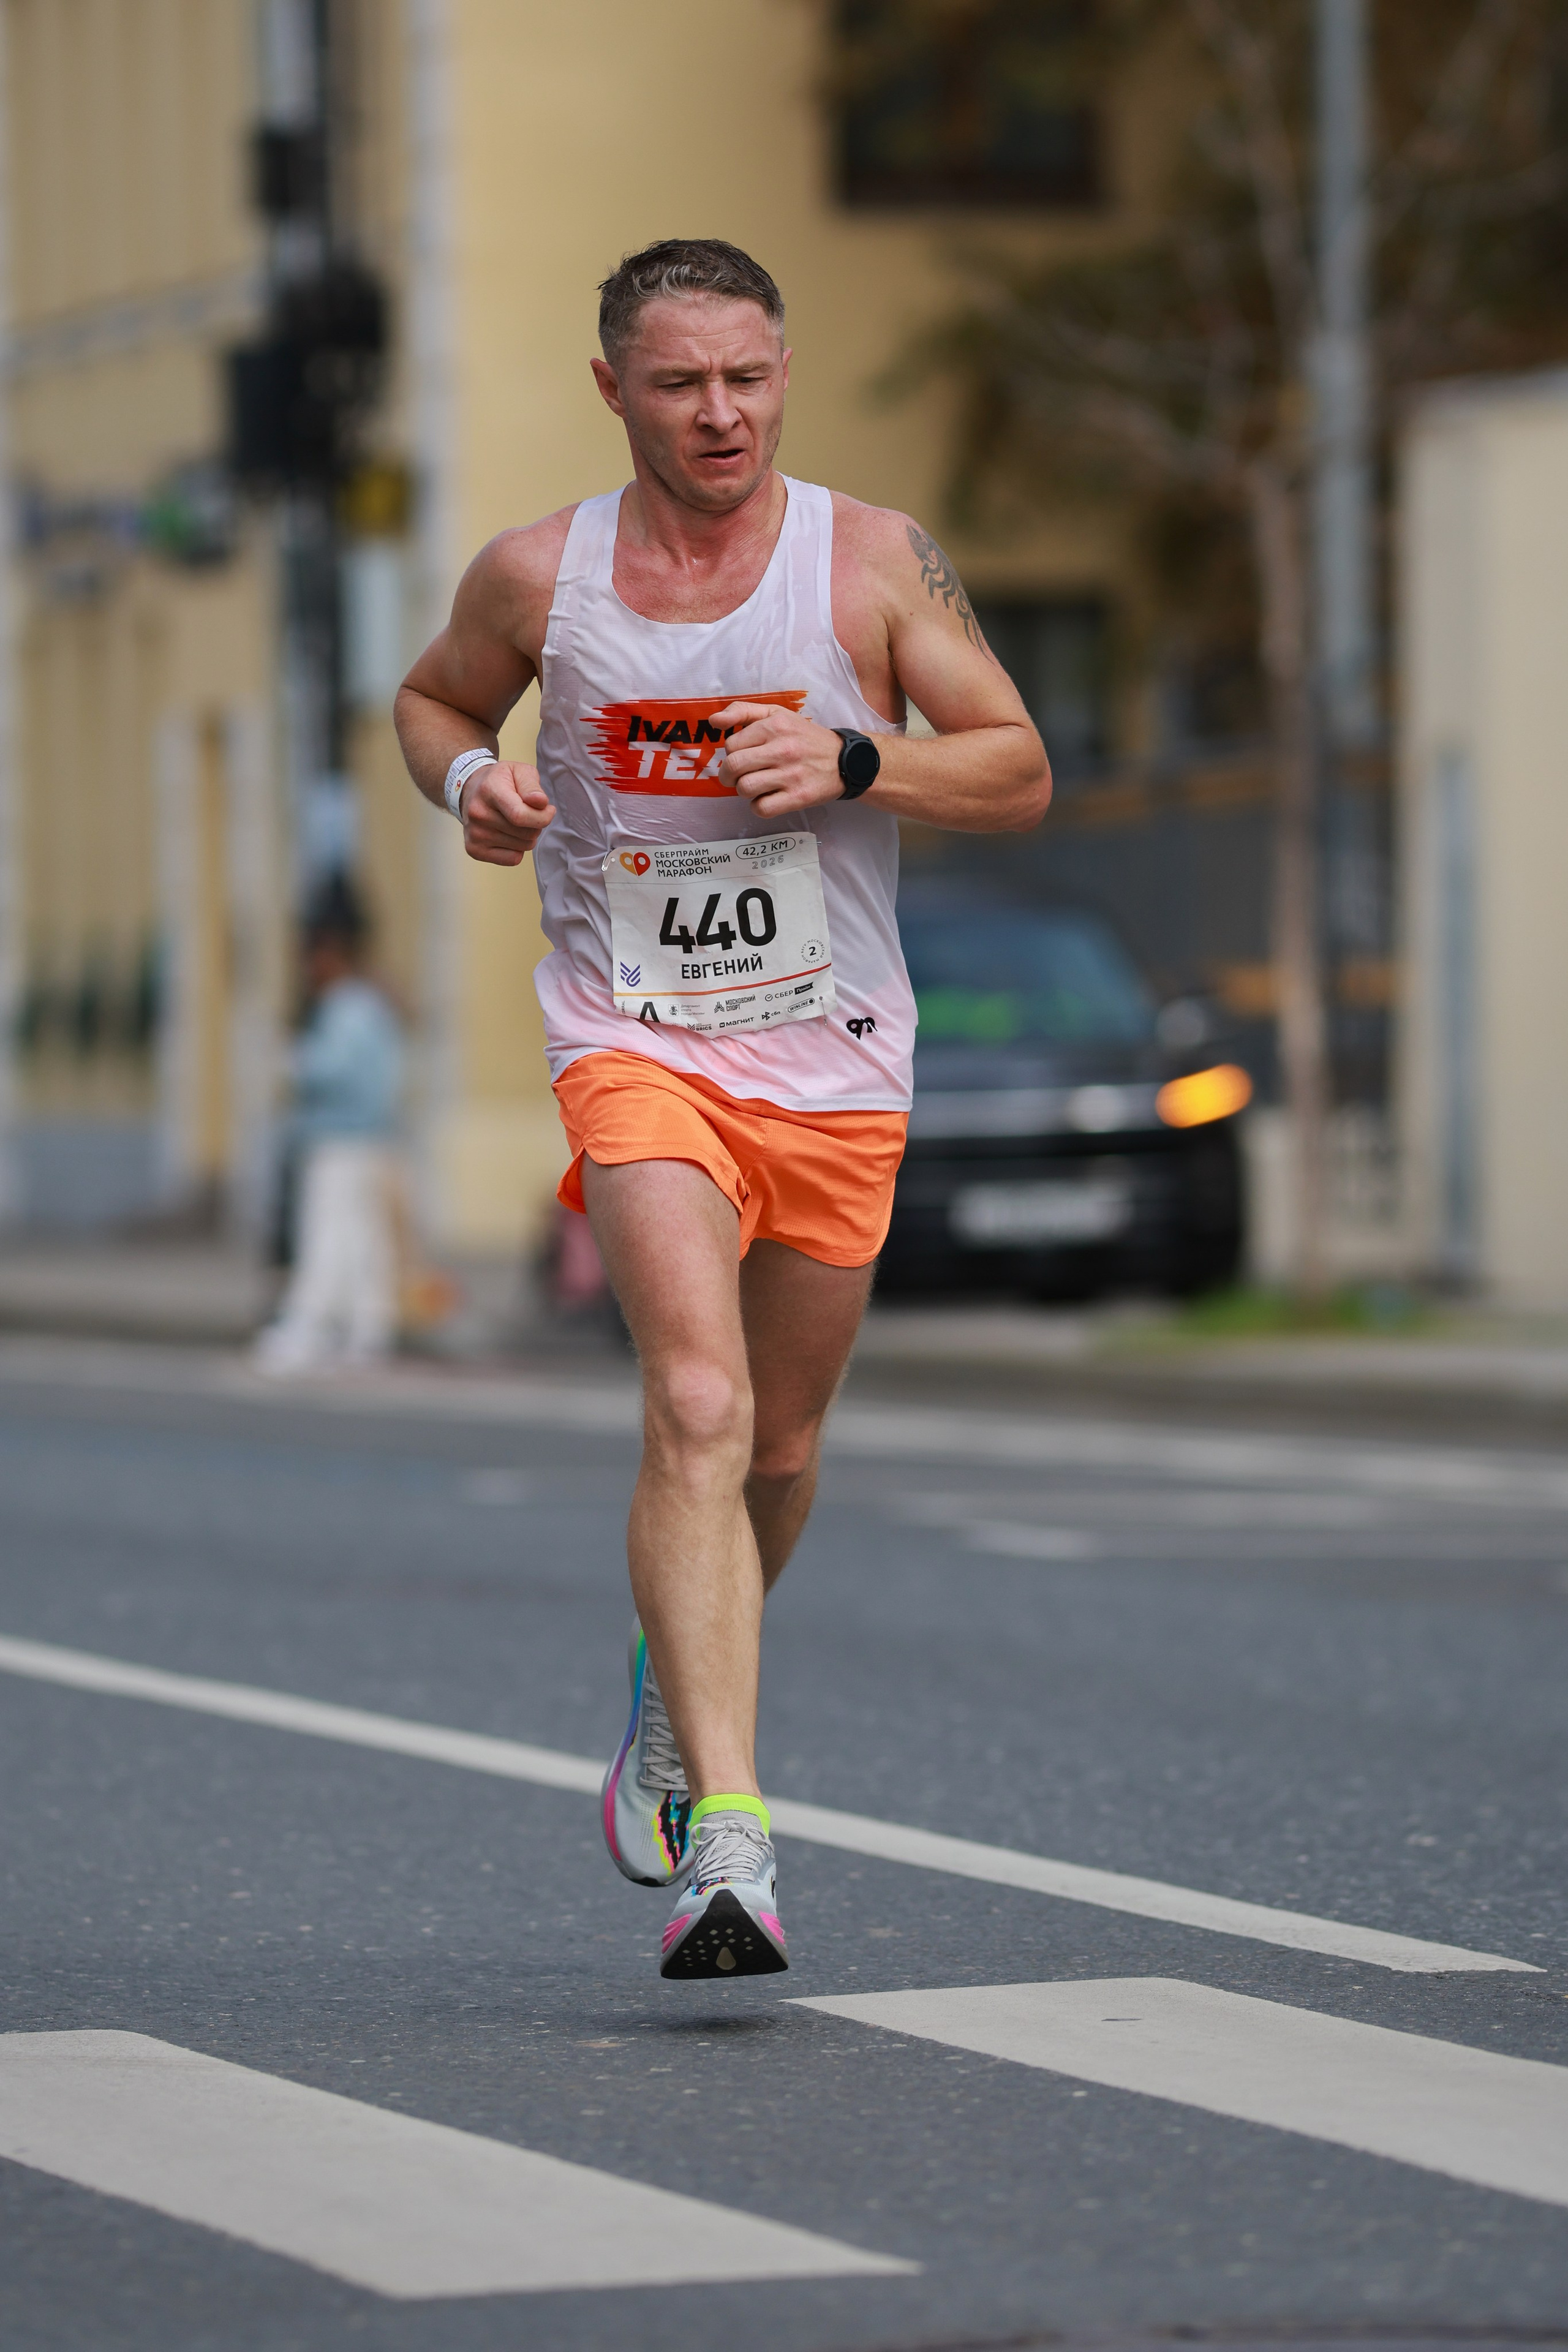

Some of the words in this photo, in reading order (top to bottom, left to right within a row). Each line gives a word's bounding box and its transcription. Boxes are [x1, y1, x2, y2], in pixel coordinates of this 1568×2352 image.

[627, 715, 748, 744] IVAN
[654, 848, 709, 858] СБЕРПРАЙМ
[742, 845, 767, 856] 42,2
[655, 854, 731, 868] МОСКОВСКИЙ
[752, 855, 784, 869] 2026
[657, 866, 712, 877] МАРАФОН
[659, 888, 777, 954] 440
[809, 946, 816, 956] 2
[681, 952, 763, 979] ЕВГЕНИЙ
[774, 990, 793, 998] СБЕР
[725, 995, 756, 1006] МОСКОВСКИЙ
[790, 1001, 809, 1011] WINLINE
[726, 1017, 754, 1027] магнит
